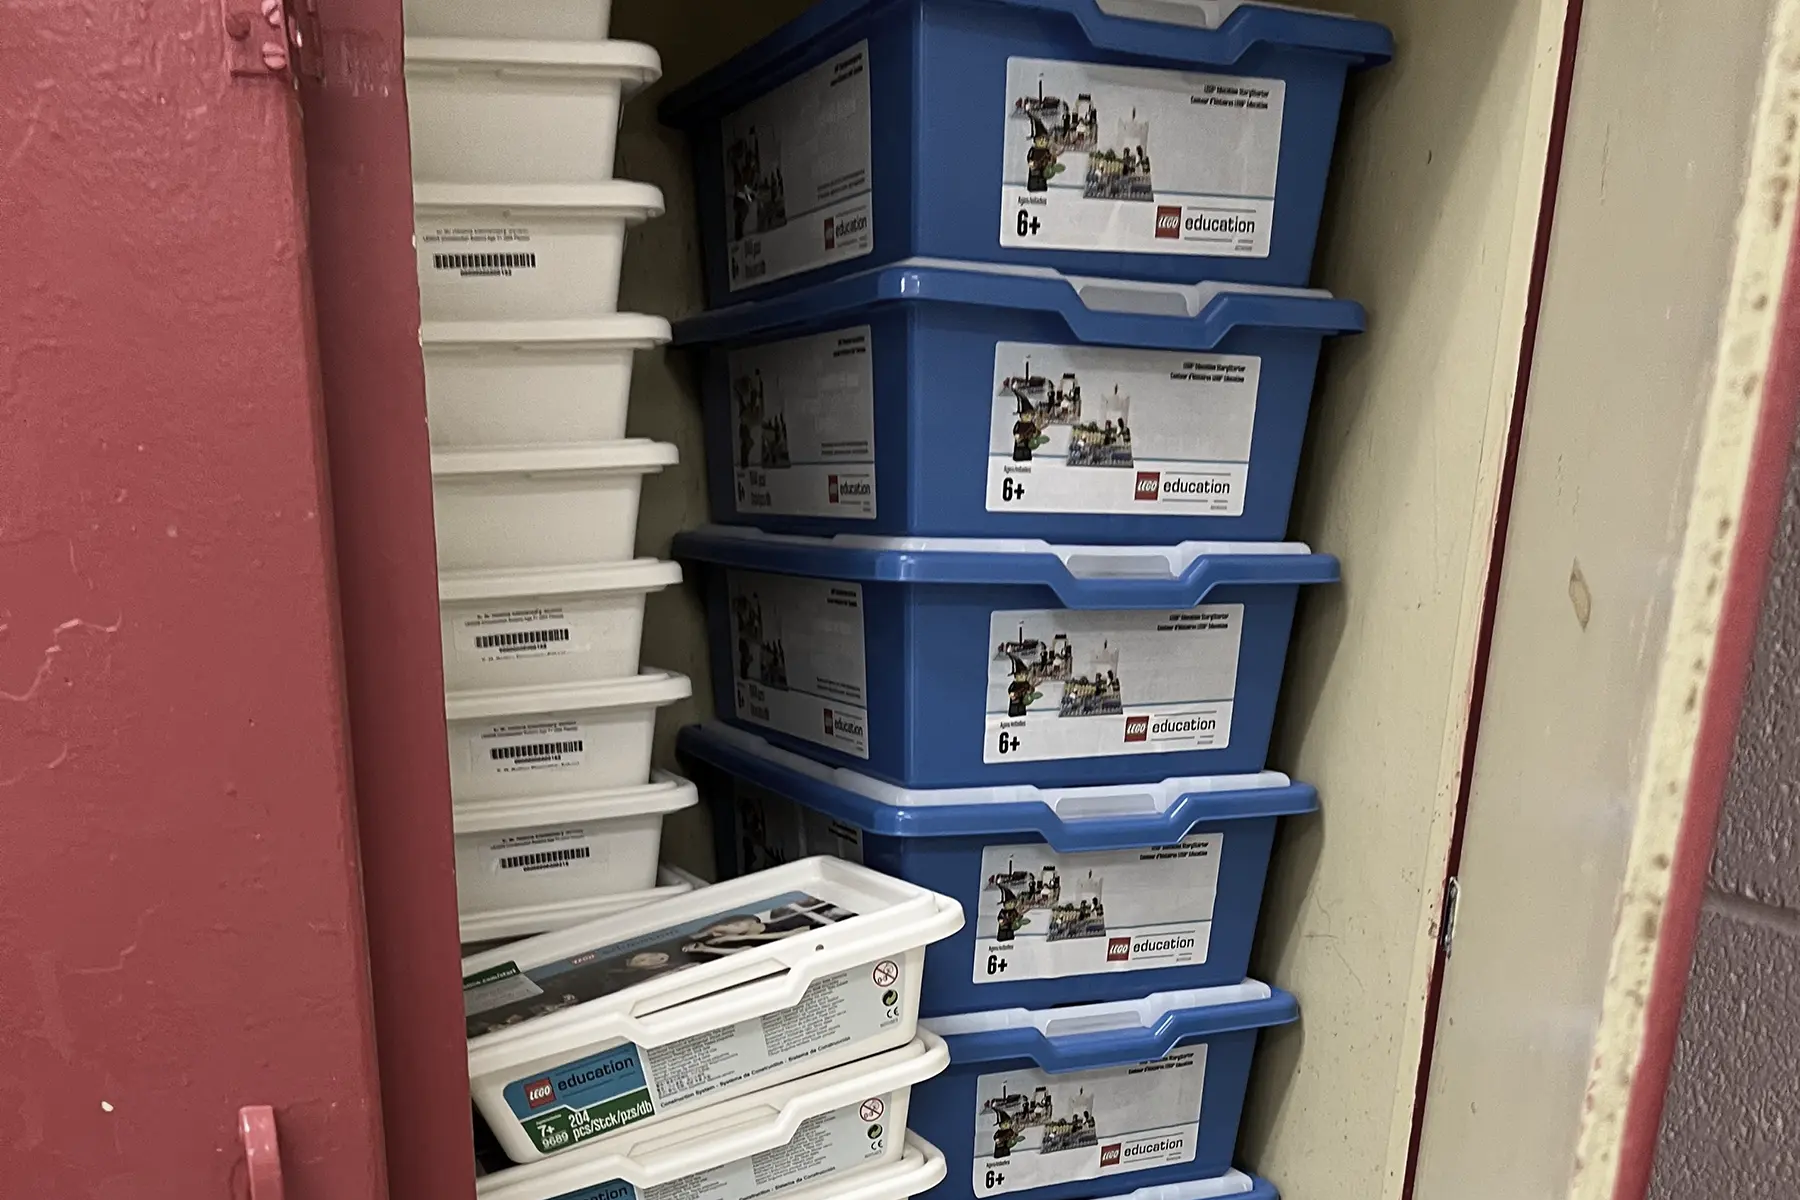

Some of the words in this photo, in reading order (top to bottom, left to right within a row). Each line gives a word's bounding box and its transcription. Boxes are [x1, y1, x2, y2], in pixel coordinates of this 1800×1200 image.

[1016, 209, 1041, 237] 6+
[1158, 215, 1179, 229] LEGO
[1185, 215, 1255, 234] education
[840, 480, 871, 495] education
[1002, 477, 1025, 502] 6+
[1138, 480, 1157, 492] LEGO
[1163, 478, 1231, 495] education
[1126, 723, 1146, 735] LEGO
[1152, 717, 1216, 734] education
[999, 731, 1020, 754] 6+
[1109, 944, 1128, 955] LEGO
[1133, 937, 1194, 953] education
[987, 955, 1008, 975] 6+
[528, 1084, 551, 1101] LEGO
[557, 1057, 634, 1091] education
[568, 1109, 590, 1128] 204
[572, 1100, 653, 1141] pcs/Stck/pzs/db
[537, 1123, 555, 1138] 7+
[542, 1131, 569, 1149] 9689
[1102, 1150, 1119, 1161] LEGO
[1124, 1138, 1183, 1157] education
[985, 1170, 1005, 1189] 6+
